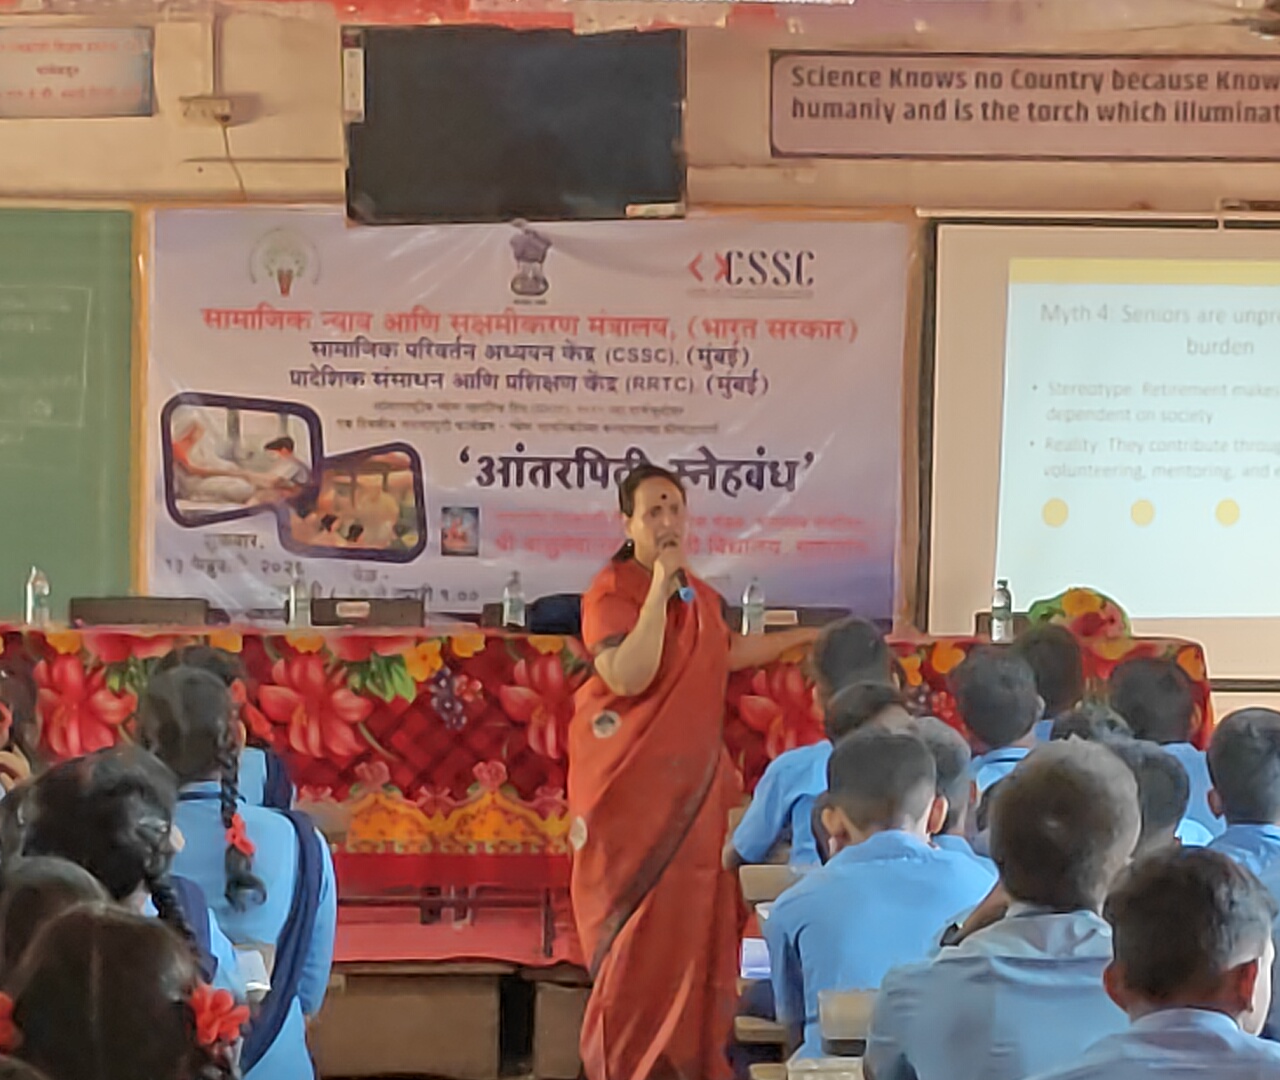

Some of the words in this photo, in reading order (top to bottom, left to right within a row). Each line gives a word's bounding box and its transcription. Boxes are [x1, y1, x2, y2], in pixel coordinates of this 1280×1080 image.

[791, 65, 882, 89] Science
[889, 67, 968, 90] Knows
[974, 69, 1003, 90] no
[1011, 69, 1104, 95] Country
[1111, 69, 1209, 92] because
[903, 99, 947, 122] and
[954, 99, 974, 122] is
[980, 100, 1020, 123] the
[1027, 99, 1089, 123] torch
[1096, 100, 1167, 124] which
[724, 250, 815, 286] CSSC
[201, 302, 313, 332] सामाजिक
[383, 304, 440, 333] आणि
[1040, 303, 1091, 325] Myth
[1121, 304, 1190, 323] Seniors
[1197, 310, 1226, 324] are
[309, 335, 400, 359] सामाजिक
[405, 335, 477, 362] परिवर्तन
[1186, 336, 1255, 356] burden
[453, 367, 500, 391] आणि
[1142, 382, 1228, 397] Retirement
[1231, 383, 1280, 397] makes
[1045, 407, 1132, 424] dependent
[1135, 409, 1156, 422] on
[1160, 408, 1214, 425] society
[1109, 437, 1146, 455] They
[1149, 438, 1230, 453] contribute
[1242, 464, 1270, 479] and
